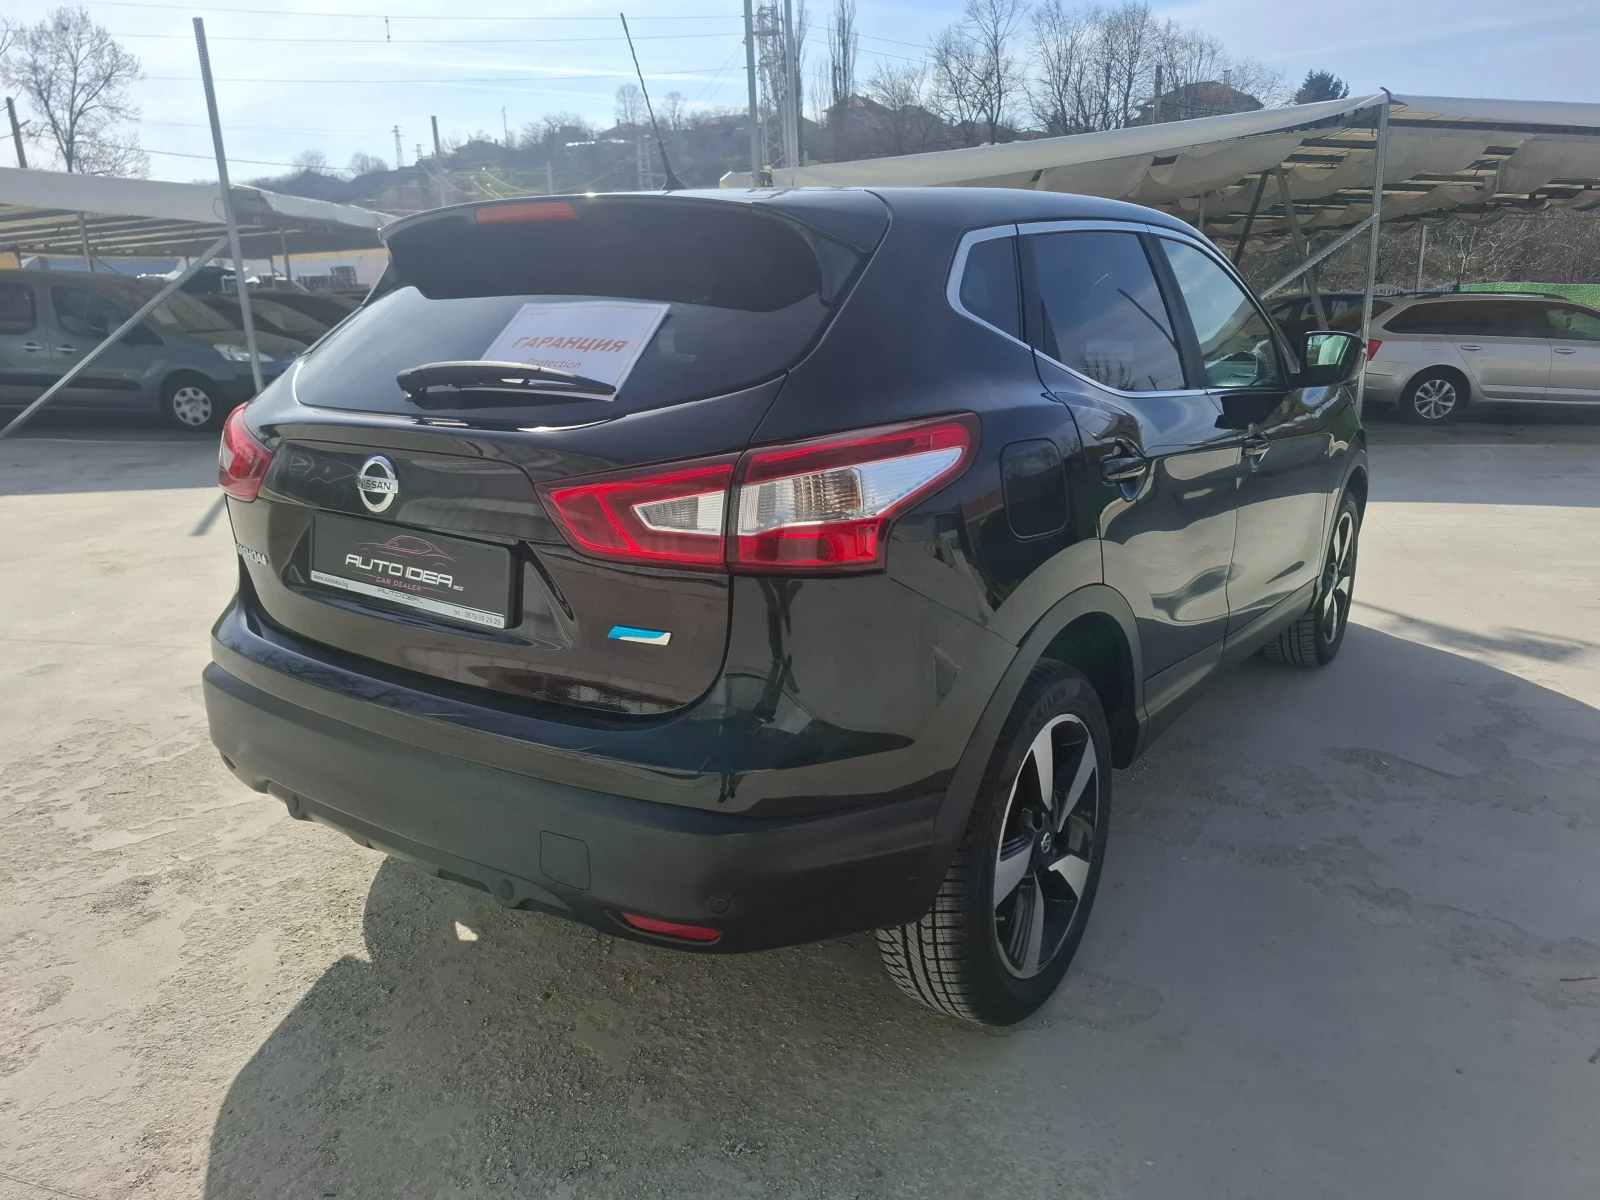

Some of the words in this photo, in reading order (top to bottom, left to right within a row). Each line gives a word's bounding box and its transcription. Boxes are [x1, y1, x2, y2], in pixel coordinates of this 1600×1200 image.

[511, 336, 630, 353] ГАРАНЦИЯ
[525, 358, 582, 369] Protection
[358, 479, 392, 491] NISSAN
[236, 543, 268, 565] ASHQAI
[345, 553, 403, 577] AUTO
[405, 566, 454, 588] IDEA
[313, 574, 349, 588] www.autoidea.bg
[375, 576, 391, 585] CAR
[393, 579, 422, 592] DEALER
[464, 611, 478, 620] 0879
